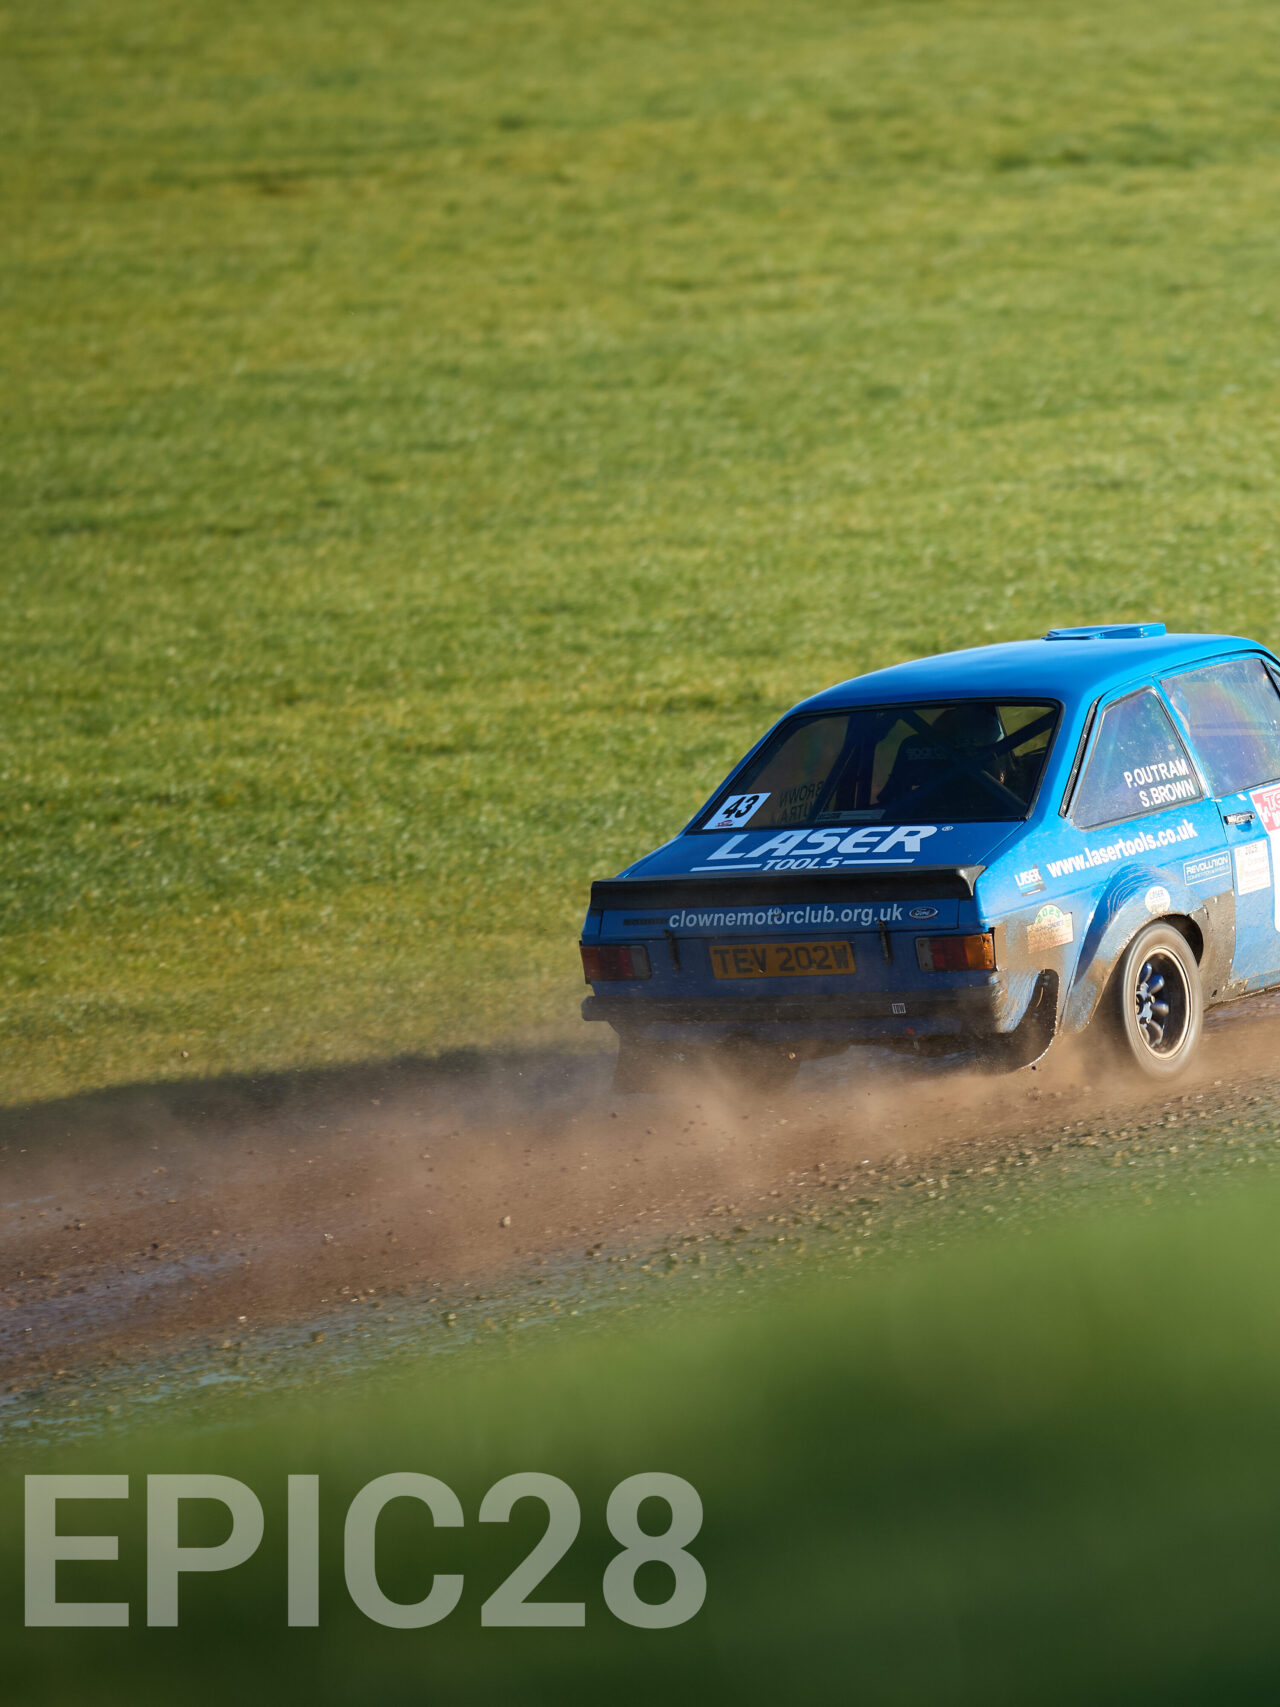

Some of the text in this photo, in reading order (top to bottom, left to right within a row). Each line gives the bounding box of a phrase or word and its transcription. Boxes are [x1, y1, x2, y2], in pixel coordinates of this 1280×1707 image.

[1124, 758, 1189, 788] P.OUTRAM
[1139, 779, 1196, 807] S.BROWN
[723, 795, 760, 819] 43
[706, 825, 938, 860] LASER
[1046, 819, 1198, 878] www.lasertools.co.uk
[762, 857, 843, 871] TOOLS
[1186, 855, 1229, 876] REVOLUTION
[1014, 868, 1042, 887] LASER
[669, 904, 904, 928] clownemotorclub.org.uk
[713, 945, 767, 975] TEV
